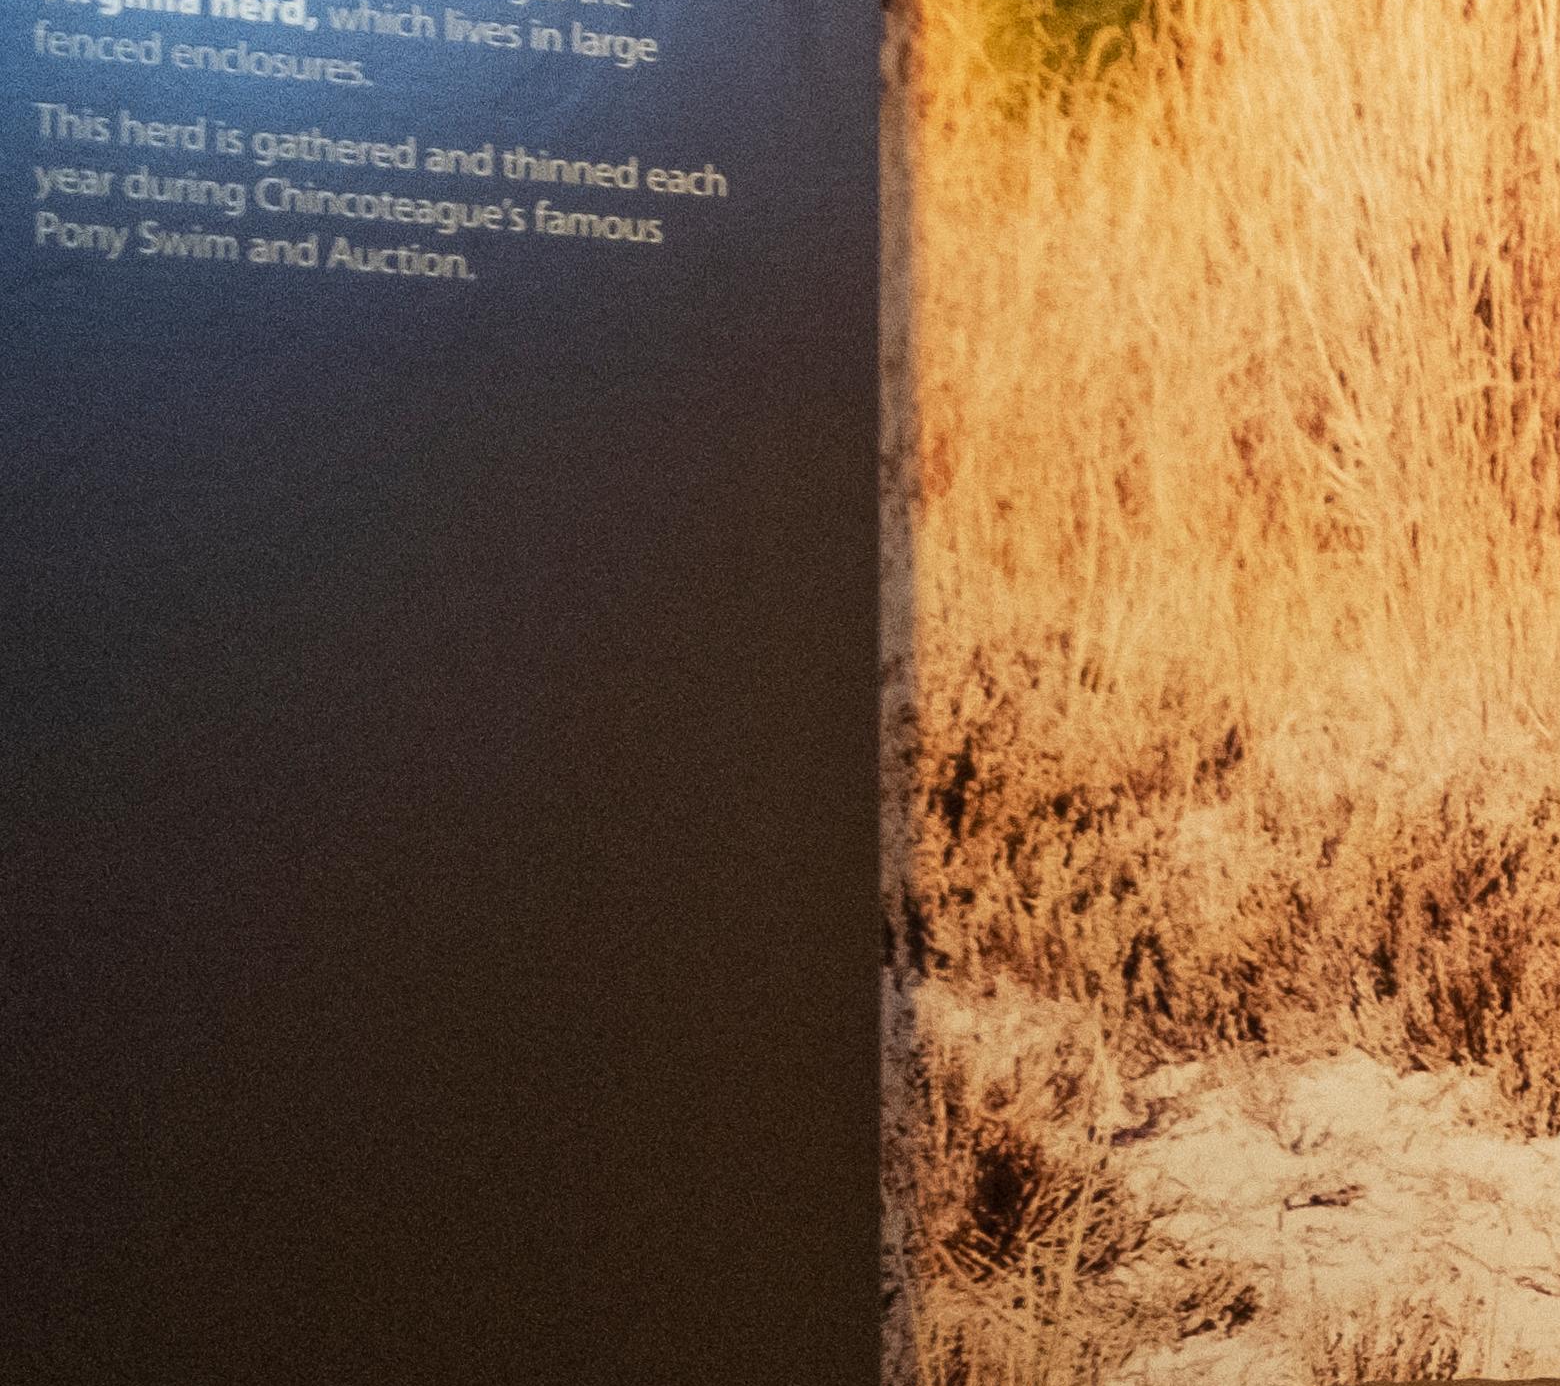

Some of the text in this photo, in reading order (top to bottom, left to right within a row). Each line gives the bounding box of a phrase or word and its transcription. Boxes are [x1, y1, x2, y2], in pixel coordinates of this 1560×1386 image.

[32, 18, 376, 89] fenced enclosures.
[445, 7, 523, 50] lives
[529, 17, 564, 54] in
[571, 19, 659, 70] large
[32, 101, 728, 199] This herd is gathered and thinned each
[34, 165, 116, 201] year
[123, 164, 247, 218] during
[534, 197, 664, 245] famous
[35, 210, 478, 282] Pony Swim and Auction.
